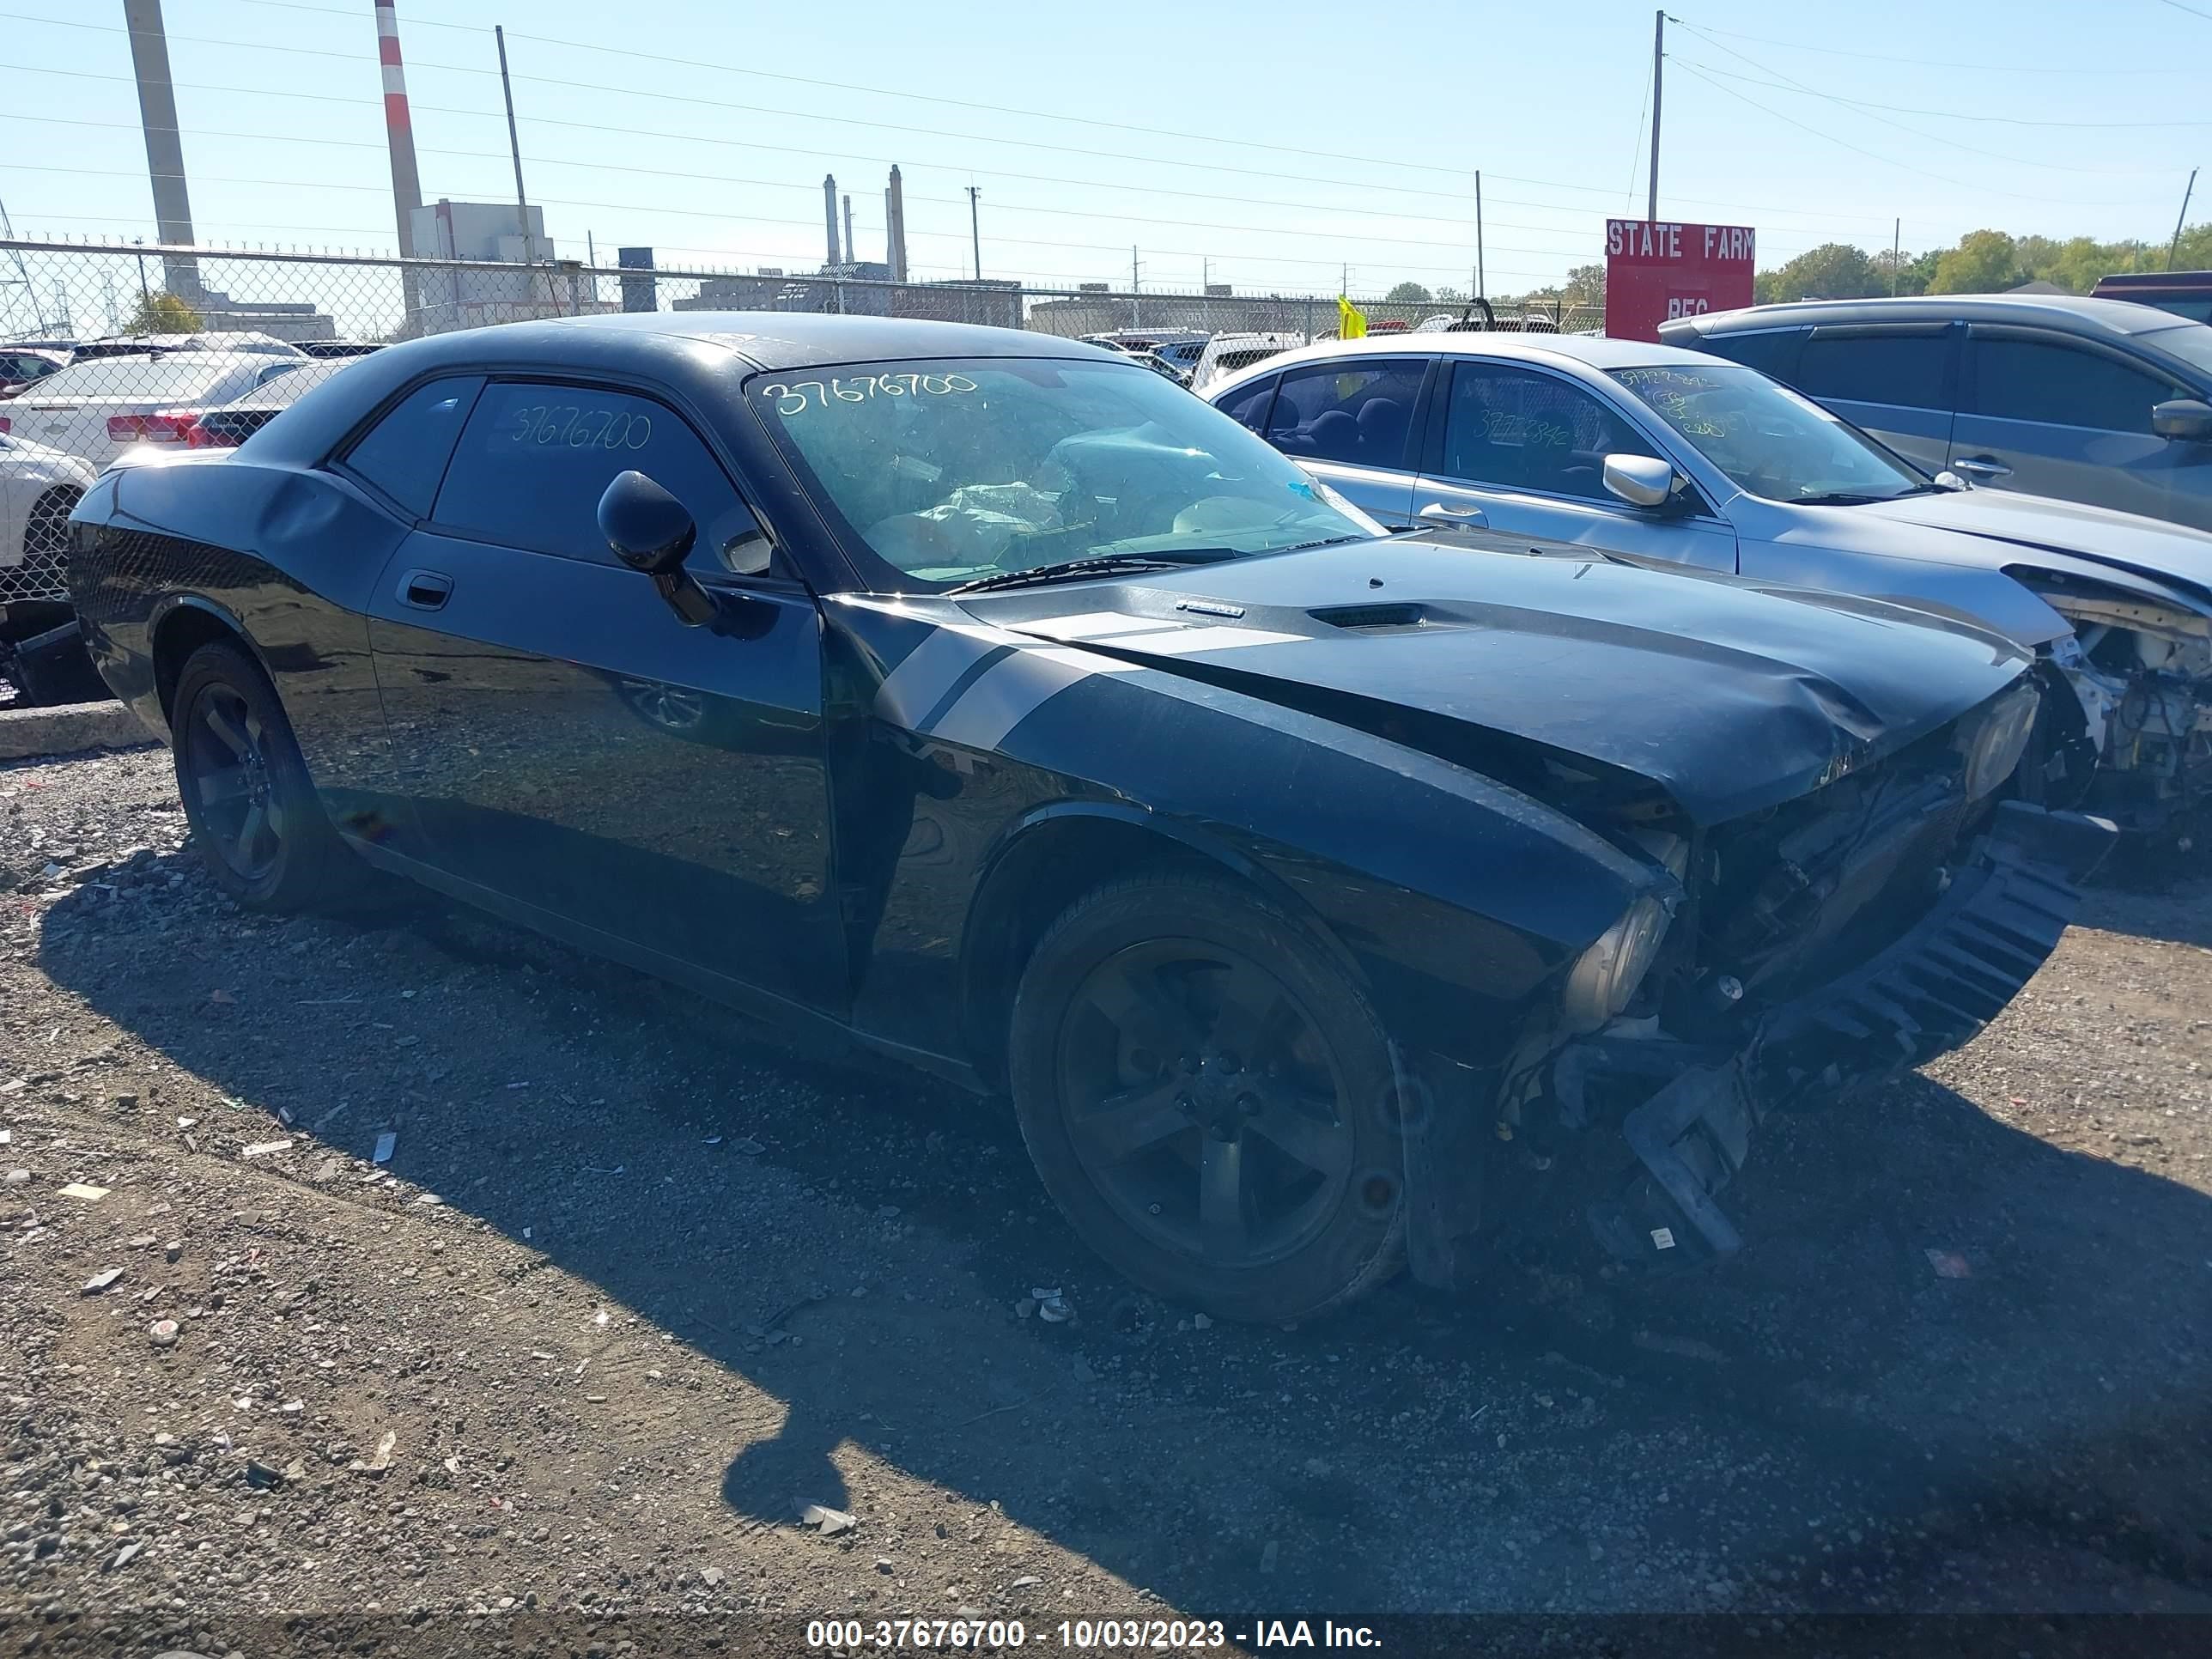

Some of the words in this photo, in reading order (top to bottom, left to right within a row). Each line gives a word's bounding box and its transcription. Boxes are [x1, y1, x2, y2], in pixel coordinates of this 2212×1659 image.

[1608, 222, 1682, 258] STATE
[1705, 227, 1755, 260] FARM
[763, 374, 978, 415] 37676700
[512, 405, 651, 449] 37676700
